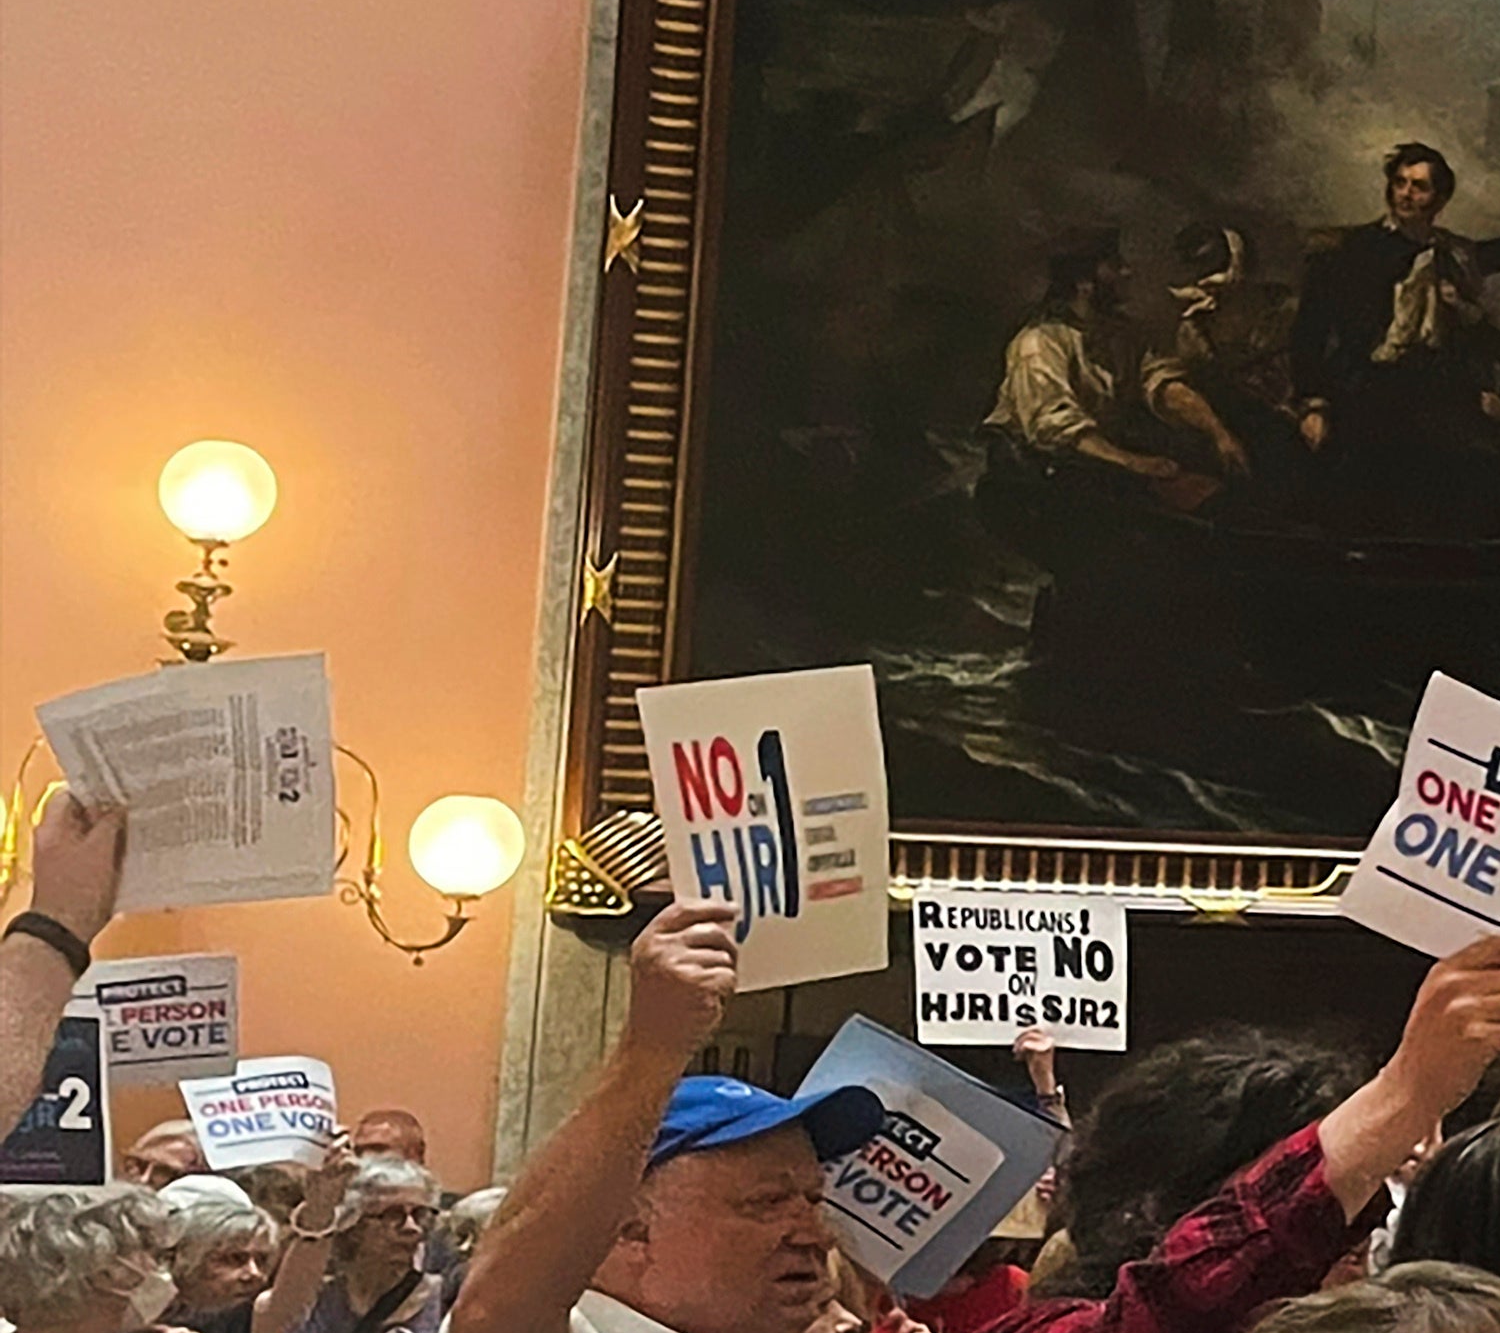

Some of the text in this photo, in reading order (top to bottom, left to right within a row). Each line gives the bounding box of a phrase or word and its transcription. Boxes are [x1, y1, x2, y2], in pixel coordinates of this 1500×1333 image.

[672, 736, 744, 822] NO
[1416, 770, 1500, 834] ONE
[924, 936, 1114, 982] VOTE NO
[1008, 973, 1036, 996] ON
[121, 999, 227, 1025] PERSON
[1041, 994, 1120, 1029] SJR2
[142, 1022, 228, 1049] VOTE
[199, 1098, 254, 1117] ONE
[206, 1111, 275, 1138] ONE
[857, 1133, 953, 1212] ERSON
[834, 1162, 931, 1237] VOTE
